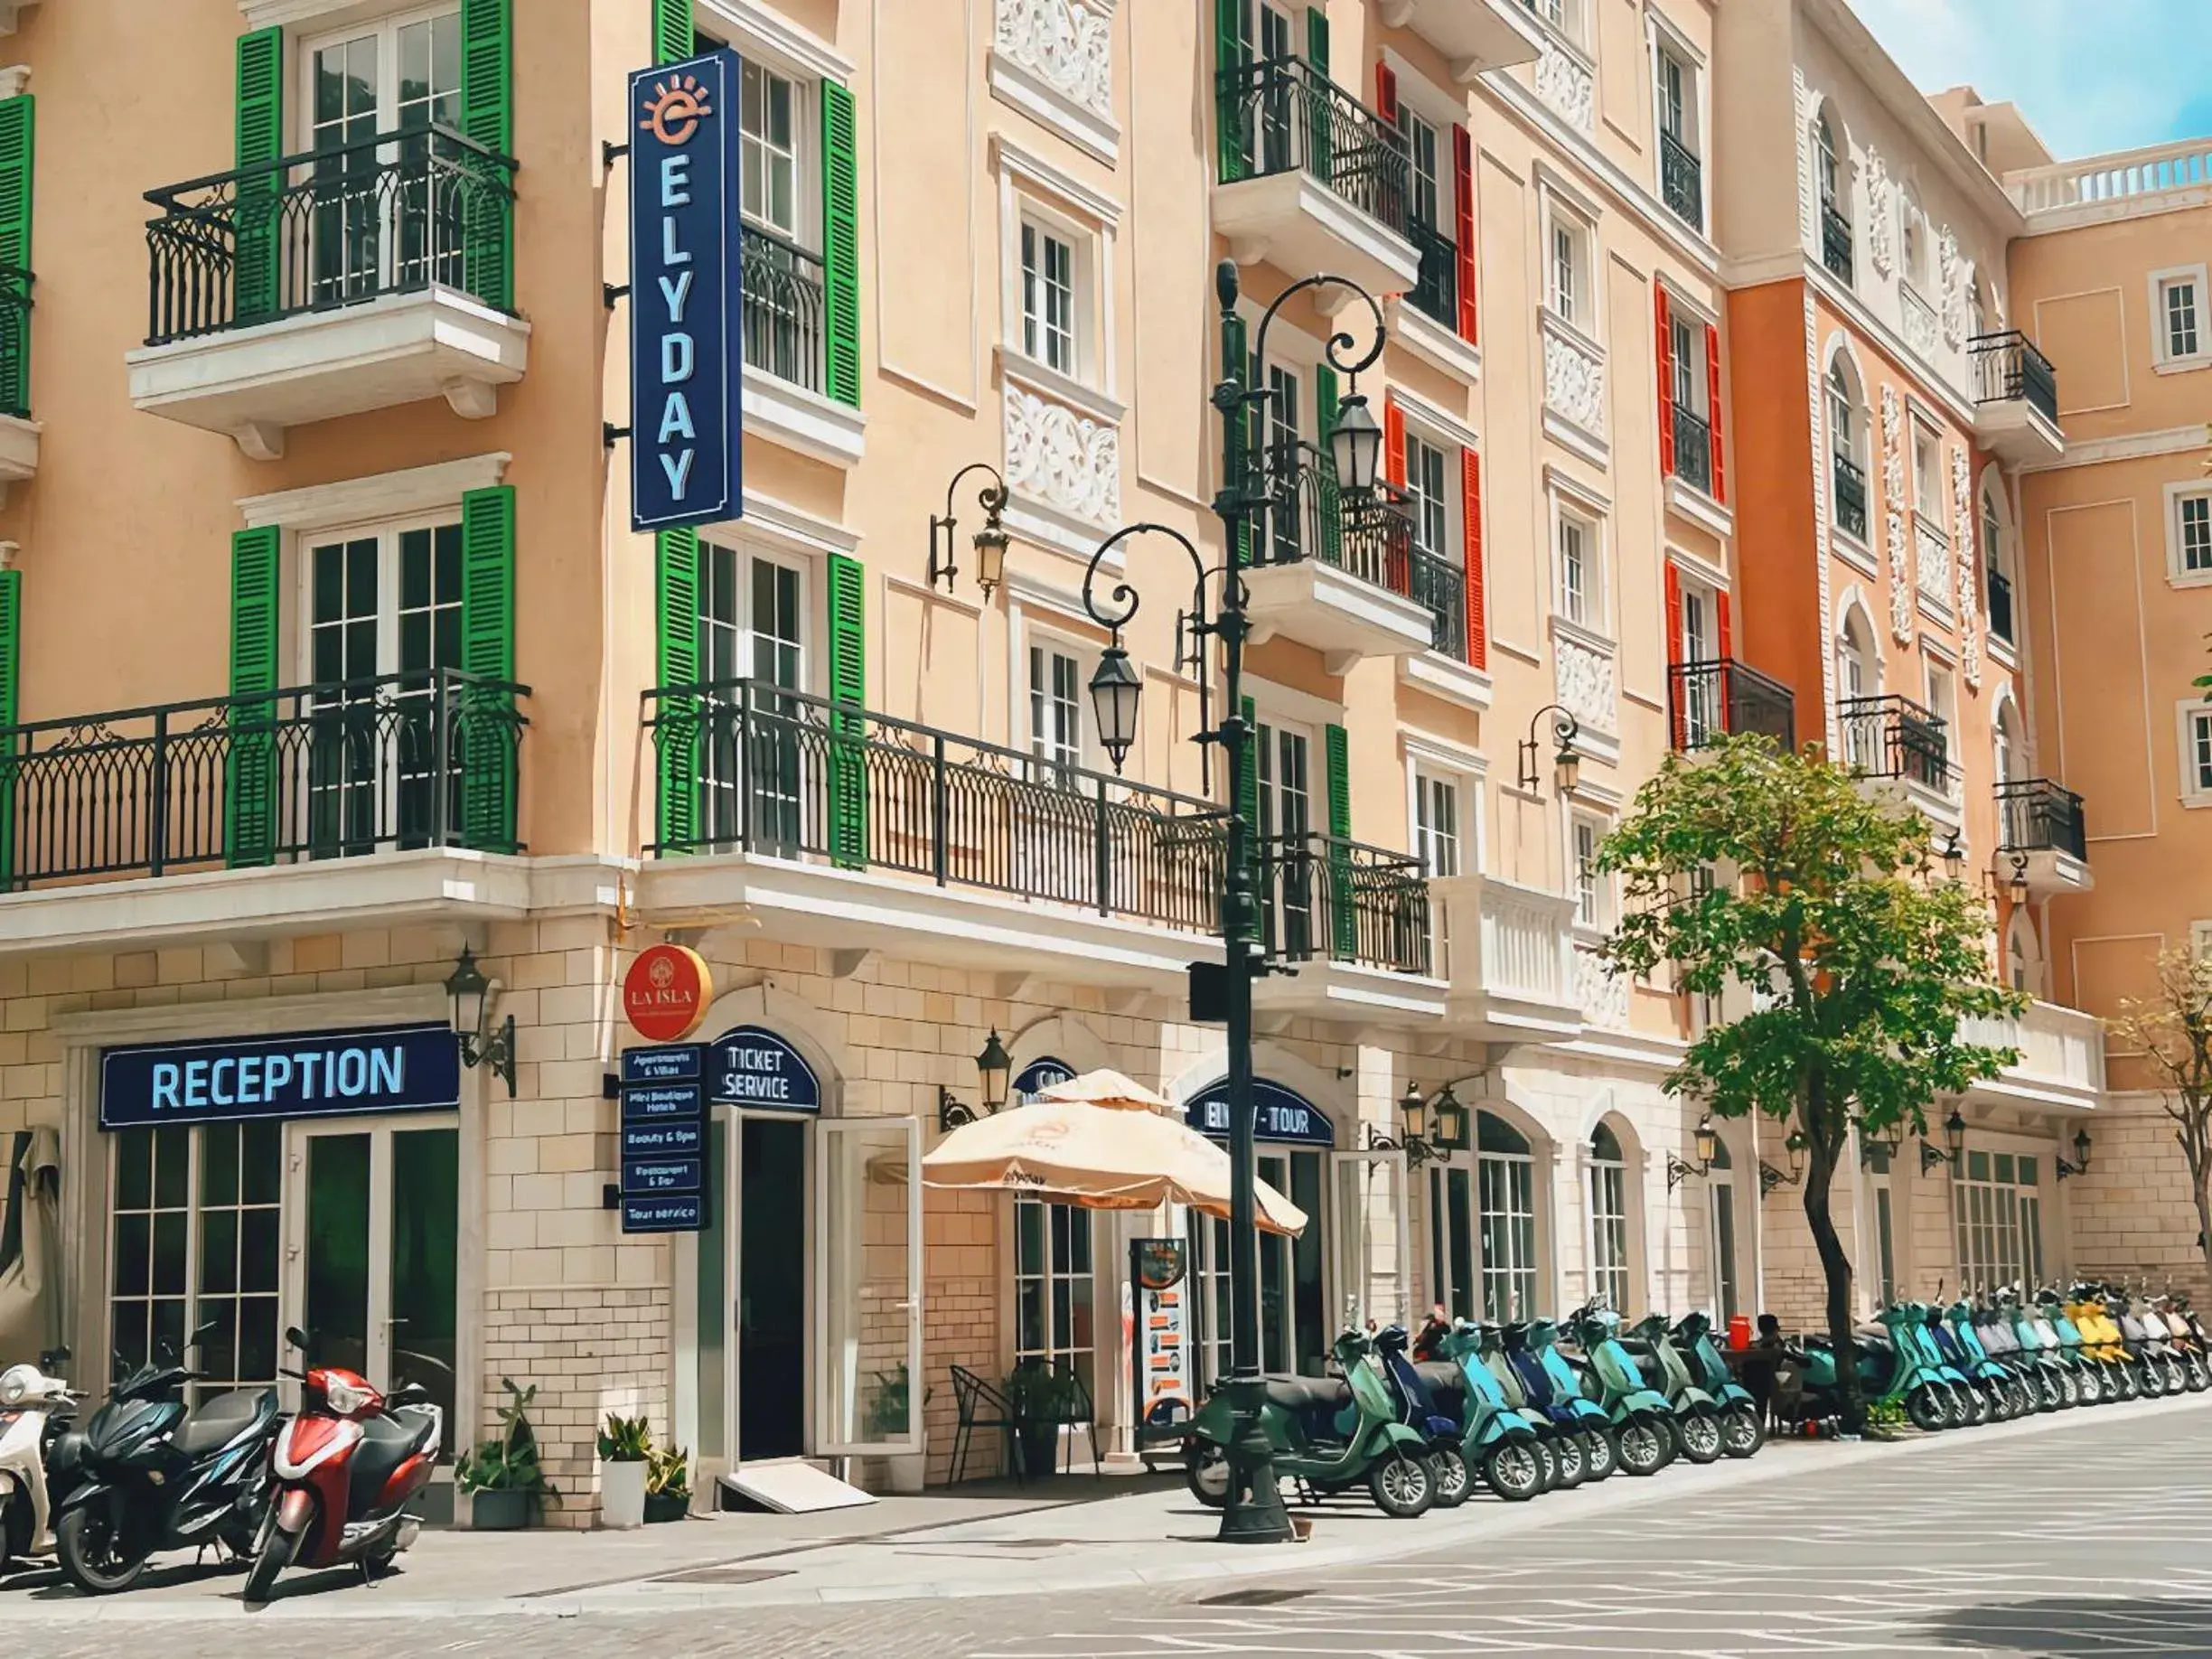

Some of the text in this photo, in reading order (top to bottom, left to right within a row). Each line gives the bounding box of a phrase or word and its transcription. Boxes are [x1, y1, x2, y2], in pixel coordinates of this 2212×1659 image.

[658, 153, 696, 502] ELYDAY
[632, 989, 692, 1005] LA ISLA
[726, 1046, 784, 1072] TICKET
[152, 1045, 405, 1110] RECEPTION
[722, 1073, 790, 1099] SERVICE
[1267, 1107, 1309, 1134] TOUR
[628, 1208, 652, 1219] Tour
